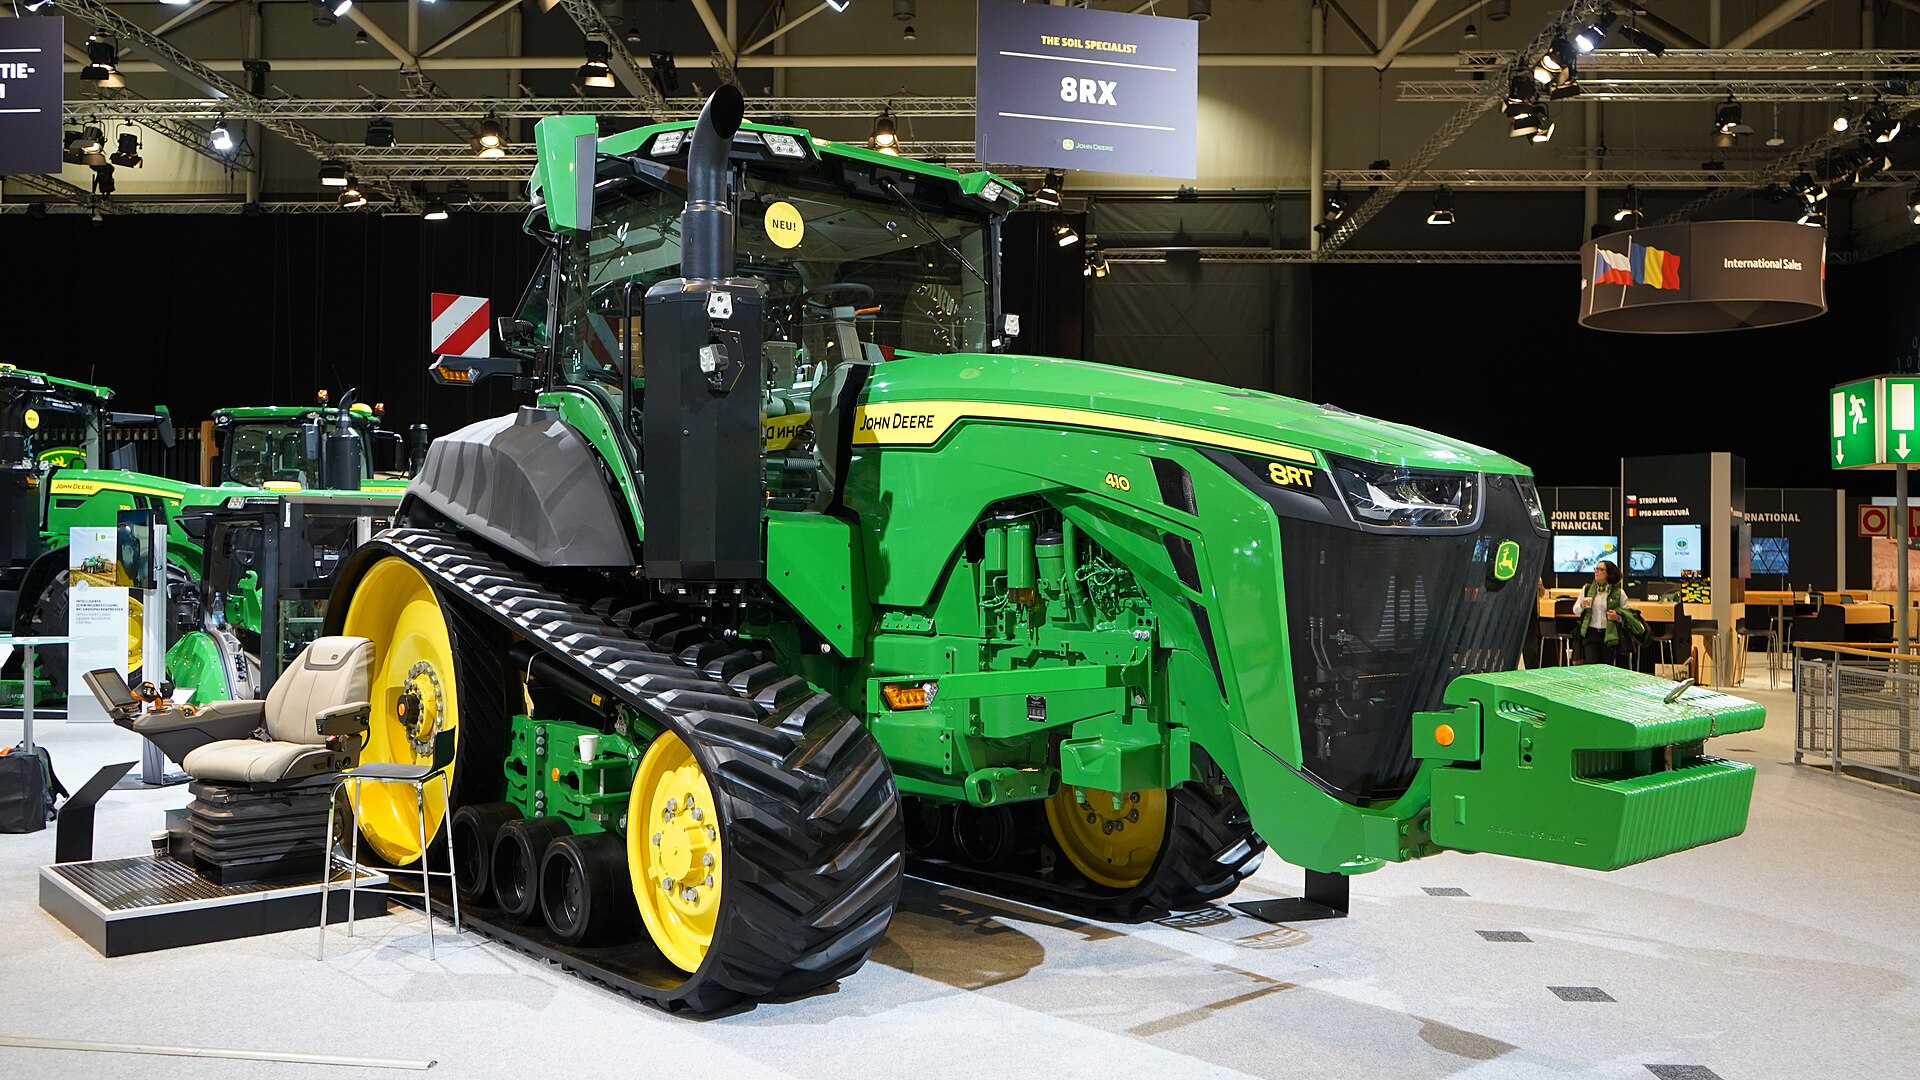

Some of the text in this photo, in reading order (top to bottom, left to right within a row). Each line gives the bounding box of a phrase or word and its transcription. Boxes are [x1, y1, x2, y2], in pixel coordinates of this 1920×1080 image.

[1041, 35, 1137, 53] THE SOIL SPECIALIST
[1060, 77, 1117, 105] 8RX
[1076, 142, 1113, 152] JOHN DEERE
[772, 219, 796, 231] NEU!
[1724, 258, 1802, 271] International Sales
[859, 413, 935, 431] JOHN DEERE
[1105, 472, 1131, 491] 410
[1268, 462, 1313, 487] 8RT
[1551, 511, 1610, 521] JOHN DEERE
[1551, 521, 1603, 531] FINANCIAL
